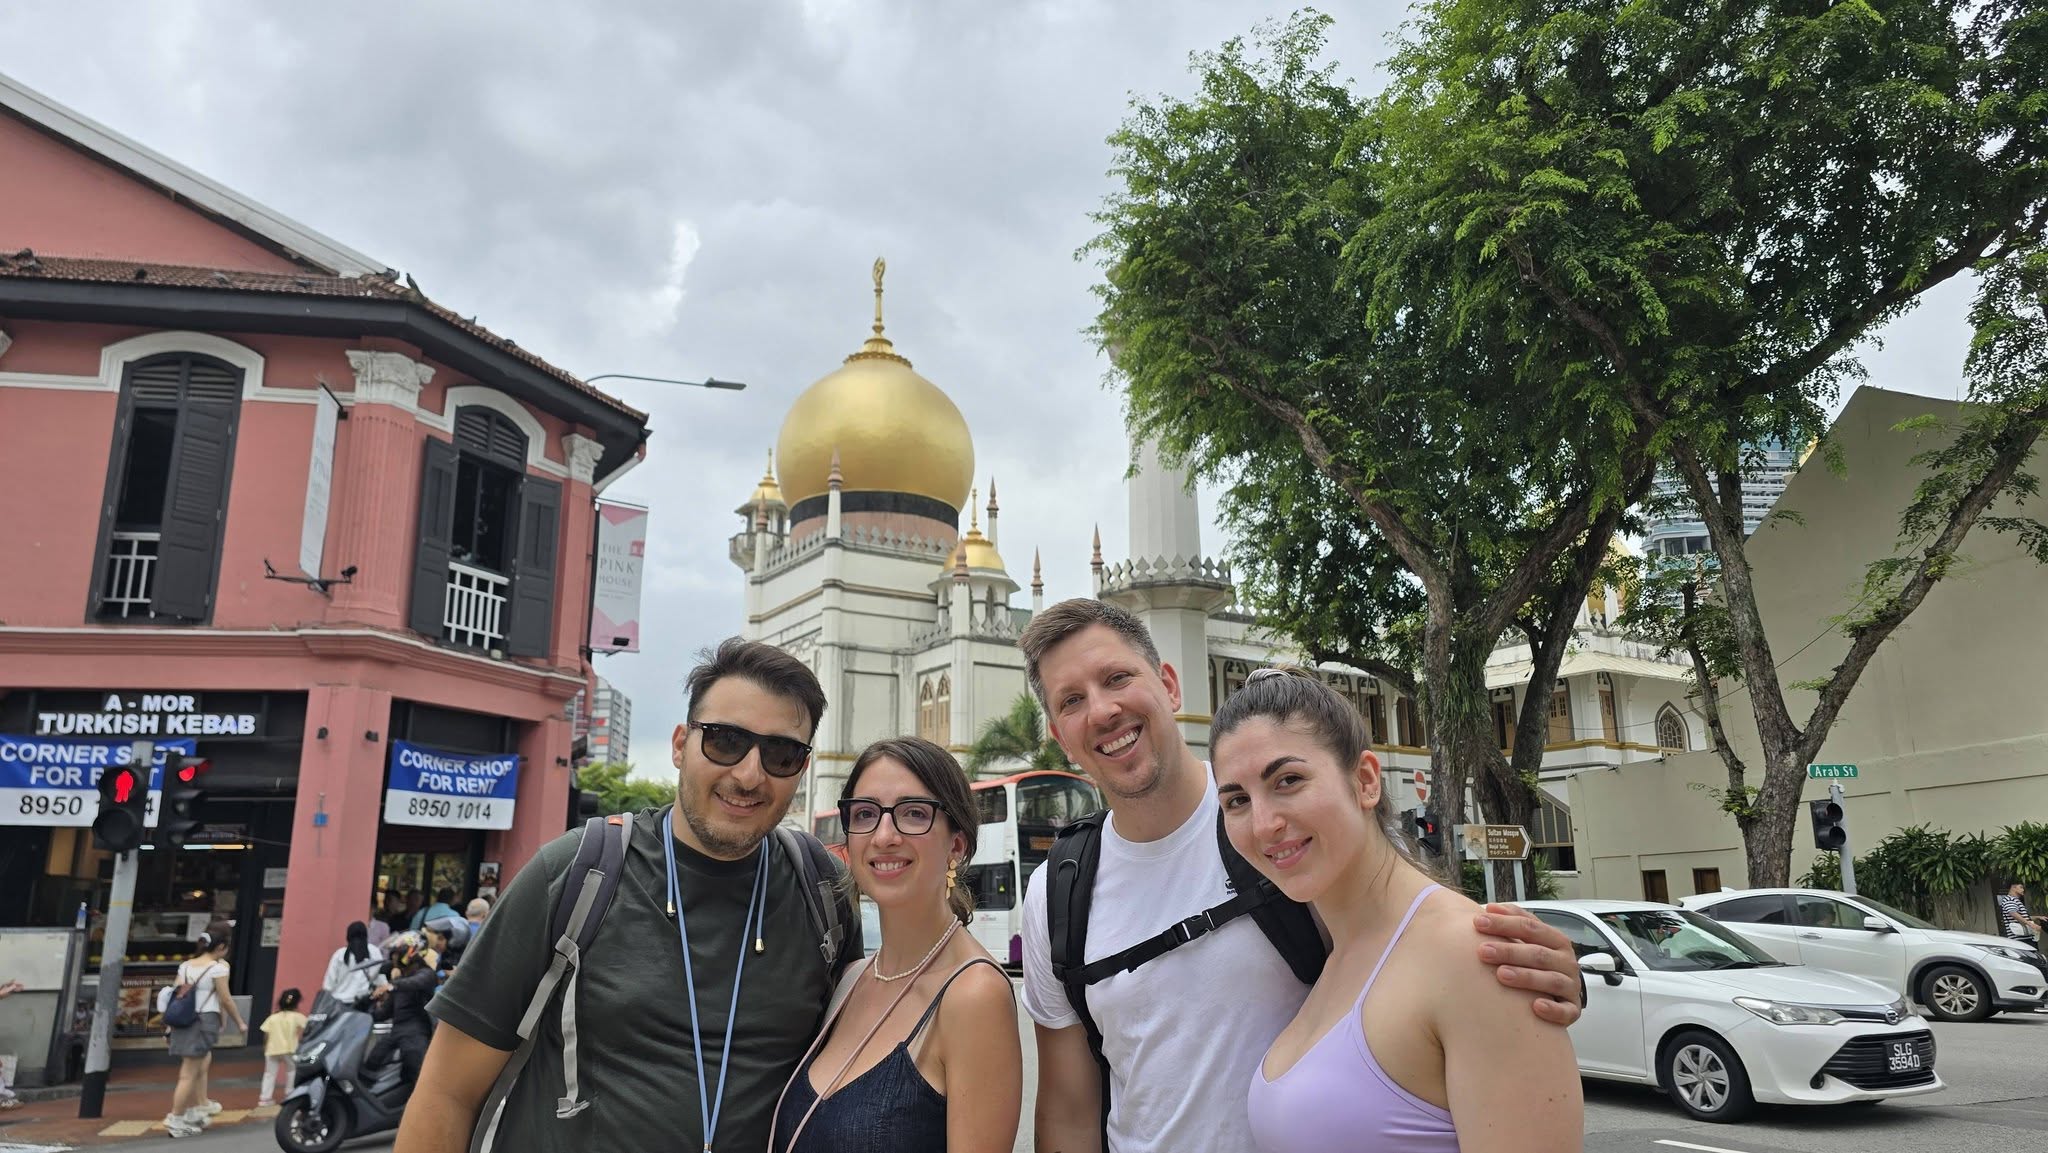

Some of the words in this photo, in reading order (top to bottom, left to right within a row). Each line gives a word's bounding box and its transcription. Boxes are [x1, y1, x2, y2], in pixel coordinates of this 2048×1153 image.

[602, 543, 622, 555] THE
[600, 557, 634, 575] PINK
[599, 575, 632, 588] HOUSE
[105, 695, 122, 712] A
[142, 695, 195, 712] MOR
[38, 713, 159, 735] TURKISH
[166, 714, 256, 735] KEBAB
[0, 743, 108, 764] CORNER
[400, 749, 466, 775] CORNER
[469, 760, 514, 776] SHOP
[29, 766, 83, 786] FOR
[1815, 765, 1840, 777] Arab
[1843, 765, 1855, 777] St
[417, 772, 454, 792] FOR
[456, 778, 498, 795] RENT
[19, 795, 83, 816] 8950
[408, 798, 450, 818] 8950
[457, 802, 491, 820] 1014
[1503, 829, 1520, 838] Mosque
[1893, 1042, 1912, 1057] SLG
[1889, 1054, 1920, 1070] 3594D
